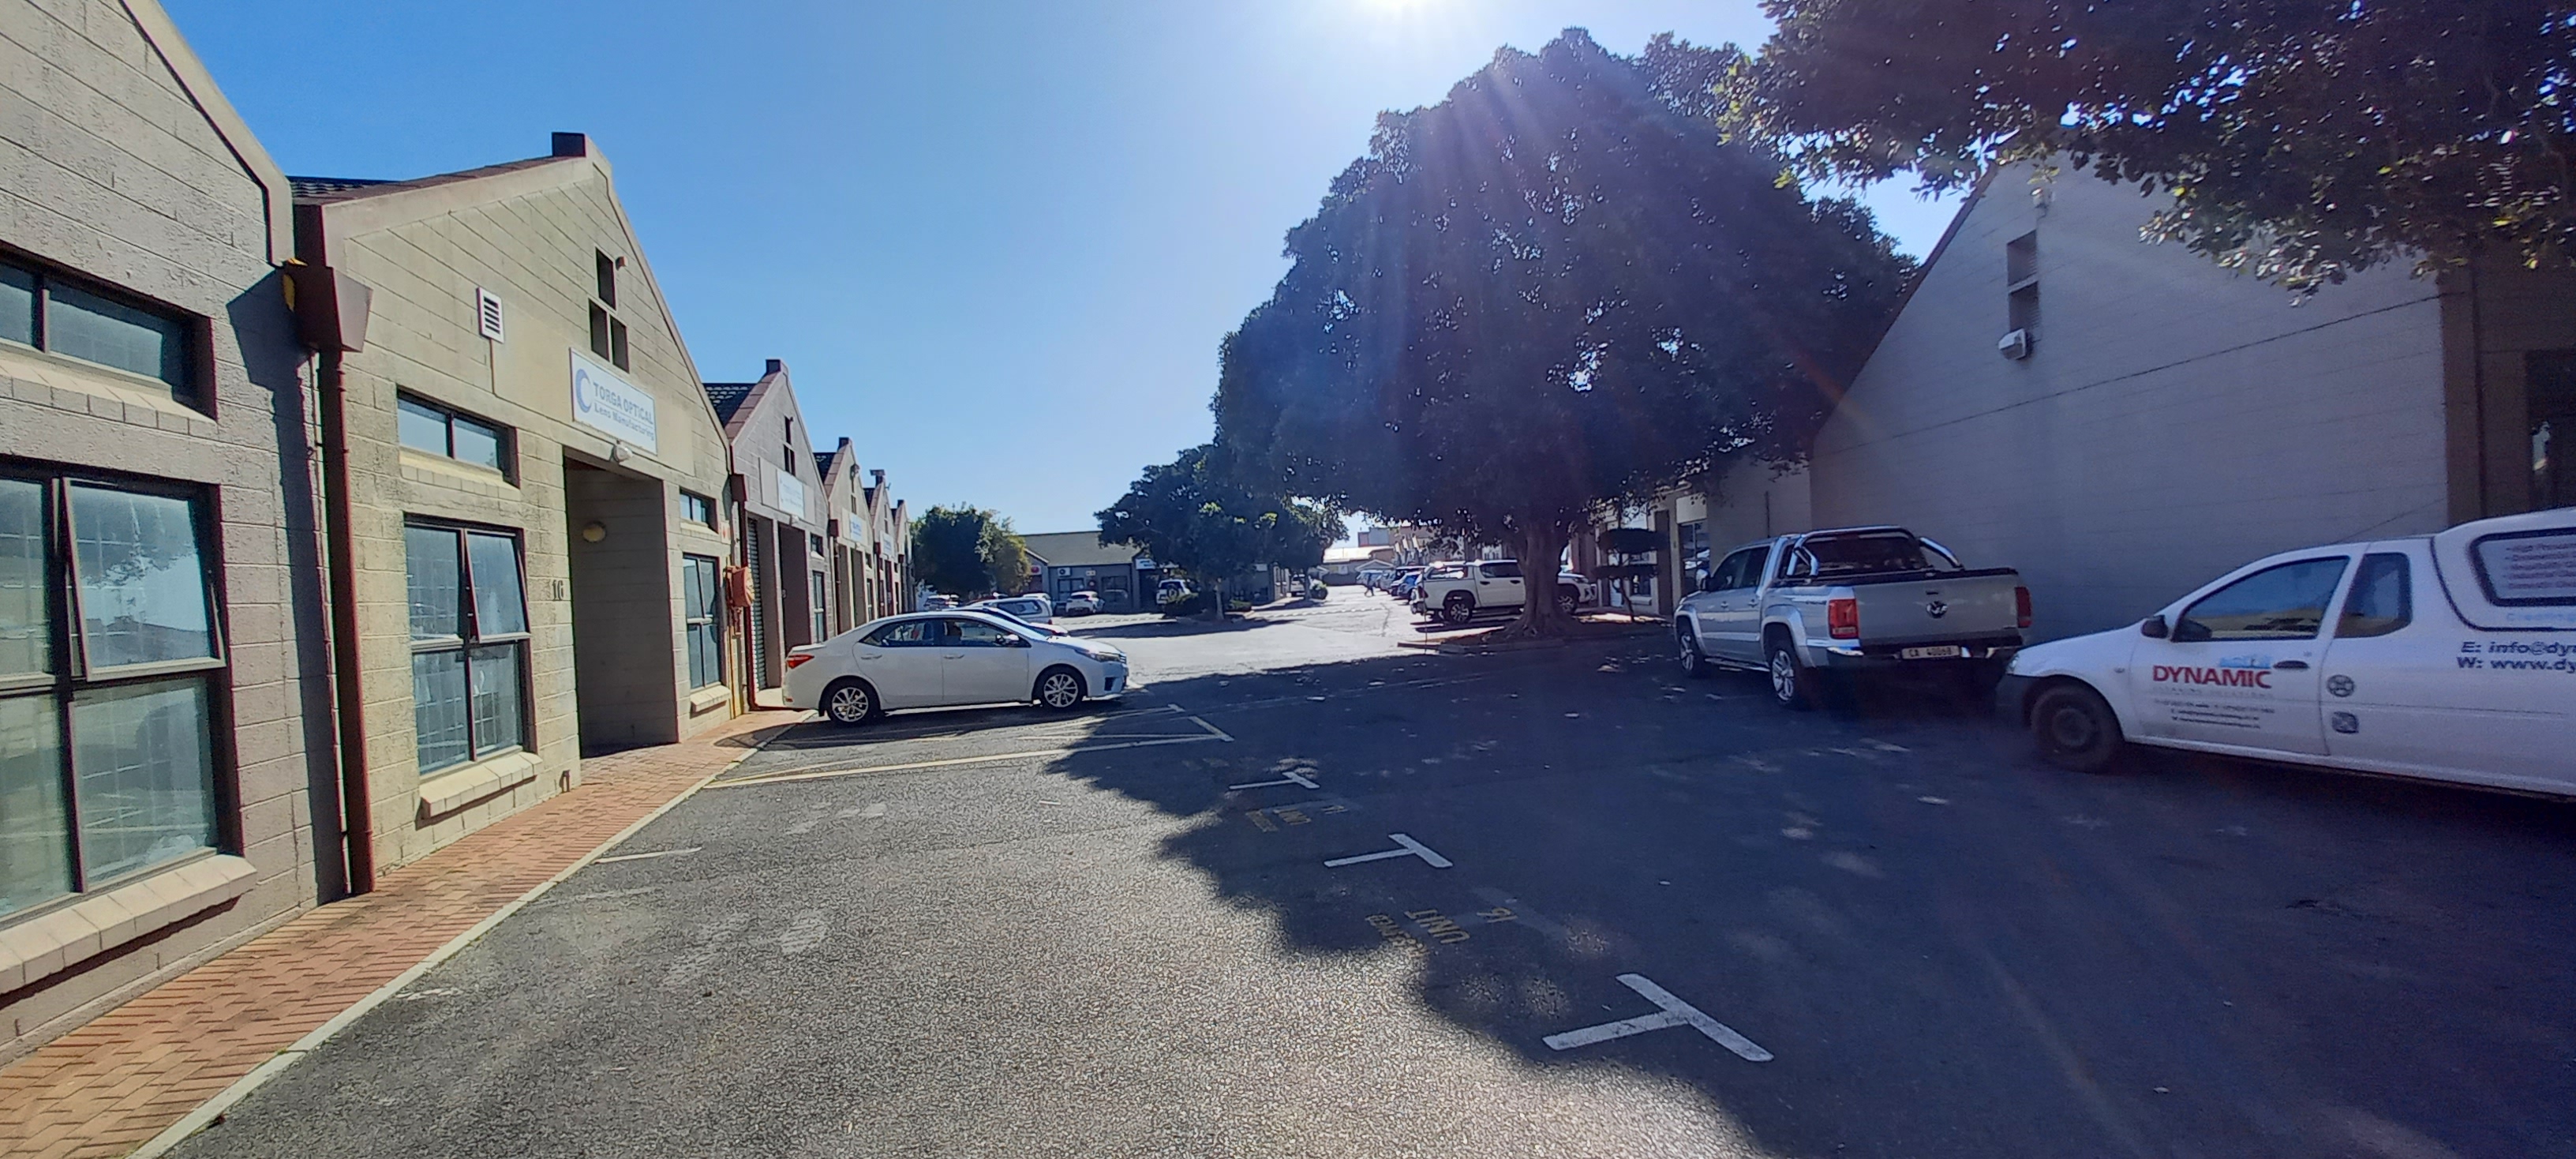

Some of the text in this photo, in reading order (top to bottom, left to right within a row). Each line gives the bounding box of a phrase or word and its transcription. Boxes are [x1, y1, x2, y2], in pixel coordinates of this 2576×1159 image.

[593, 381, 653, 426] TORGA OPTICAL
[594, 402, 654, 441] Lens Manufacturing
[2456, 656, 2484, 669] W:
[2461, 641, 2482, 654] E:
[2152, 665, 2272, 689] DYNAMIC
[1403, 909, 1471, 945] UNIT
